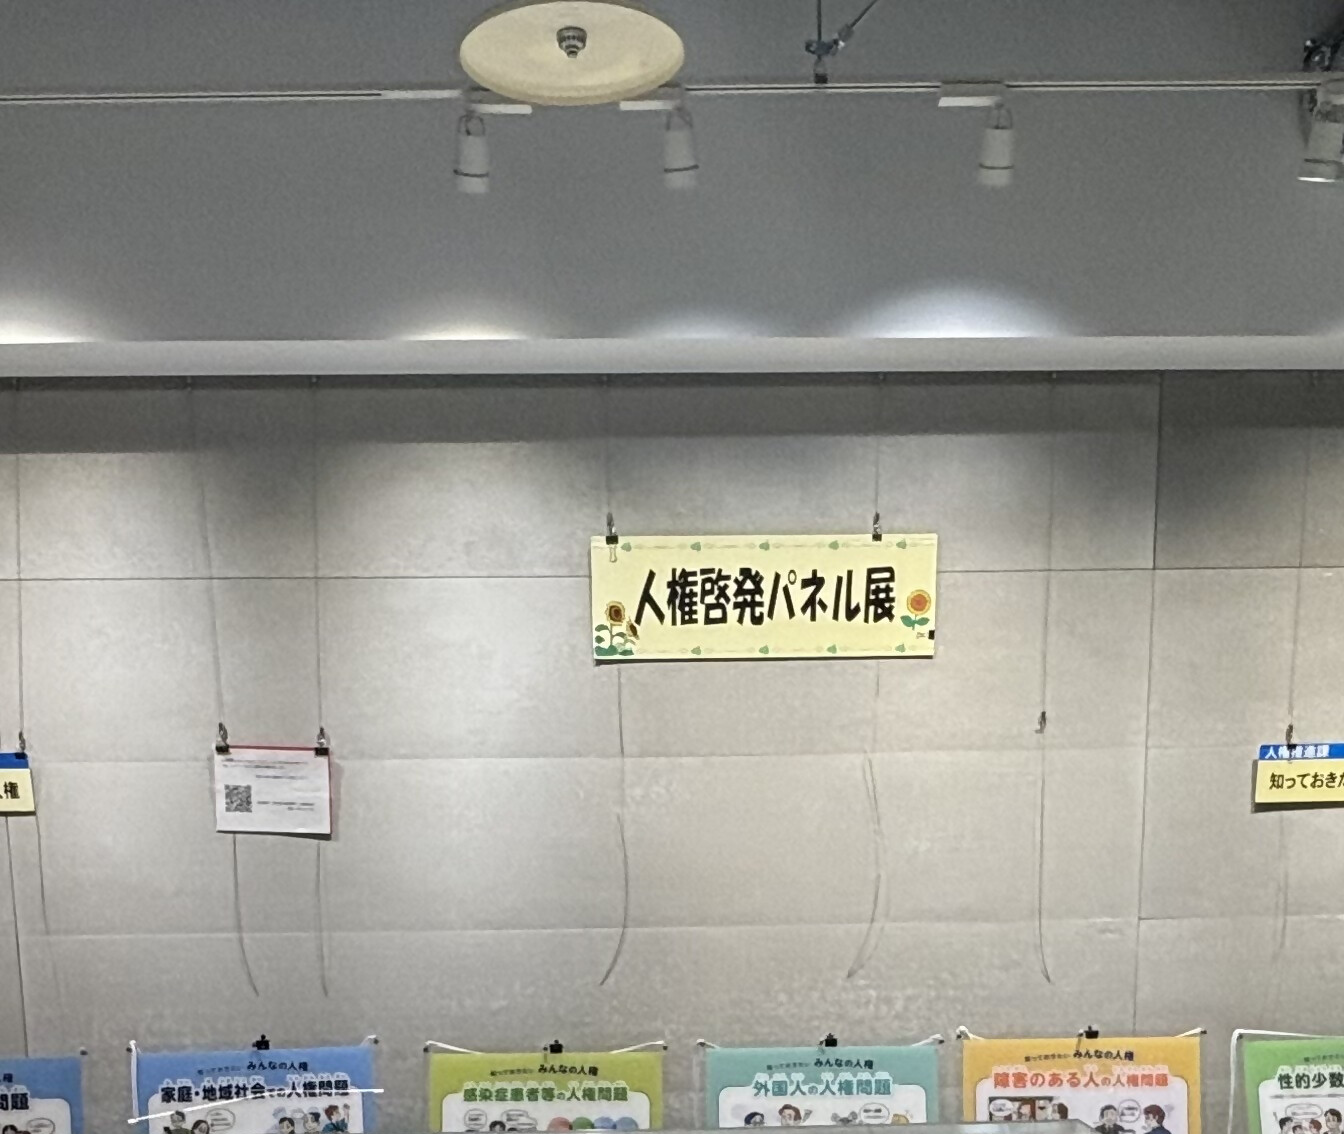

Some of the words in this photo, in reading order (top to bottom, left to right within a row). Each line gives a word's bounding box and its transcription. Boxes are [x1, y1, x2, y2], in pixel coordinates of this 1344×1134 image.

[635, 566, 896, 626] 人権啓発パネル展
[1073, 1050, 1134, 1061] みんなの人権
[246, 1060, 308, 1072] みんなの人権
[537, 1064, 599, 1076] みんなの人権
[814, 1058, 874, 1070] みんなの人権
[993, 1071, 1169, 1089] 障害のある人の人権問題
[463, 1085, 629, 1102] 感染症患者等の人権問題
[753, 1078, 892, 1097] 外国人の人権問題
